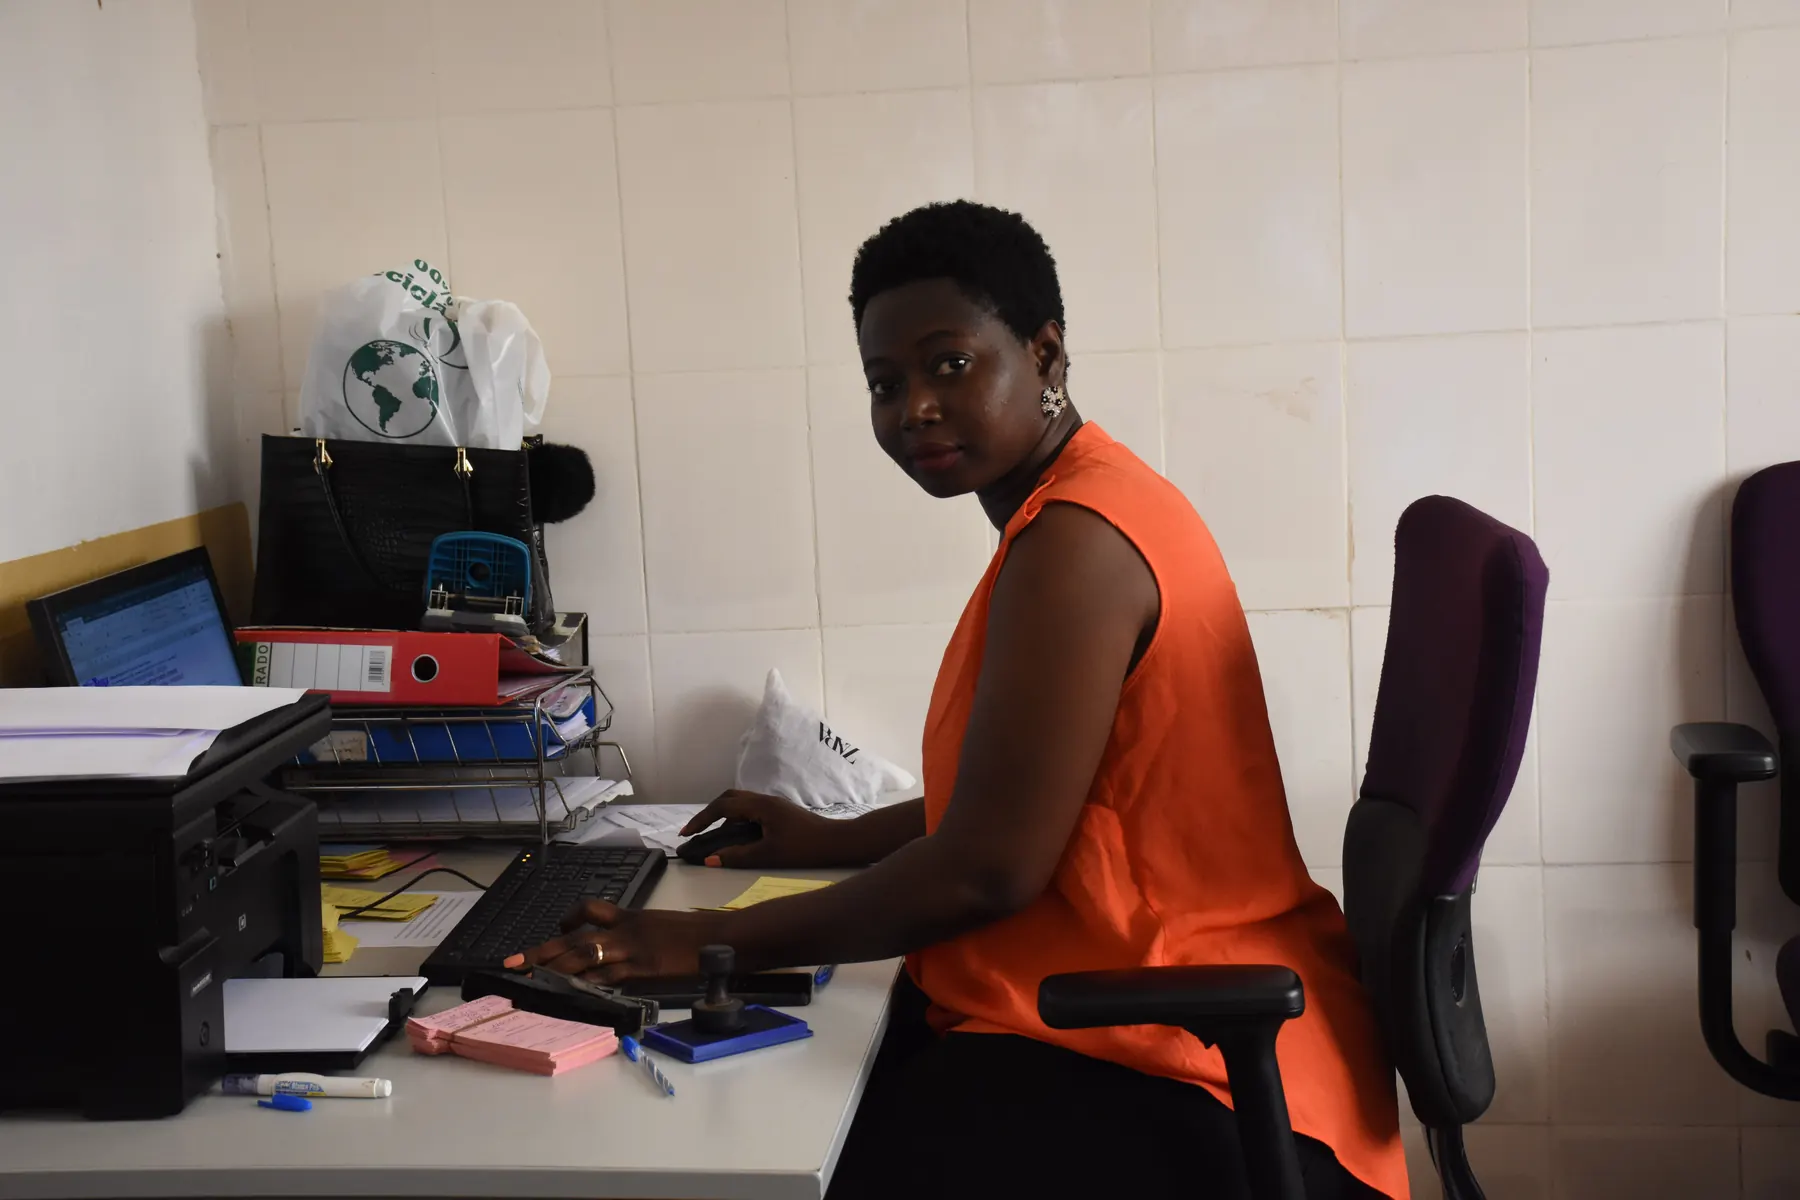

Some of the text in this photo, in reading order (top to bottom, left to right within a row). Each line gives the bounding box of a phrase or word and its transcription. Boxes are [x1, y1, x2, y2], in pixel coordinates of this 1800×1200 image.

[373, 271, 447, 316] cicla
[255, 644, 269, 685] RADO
[819, 721, 860, 765] ZARA
